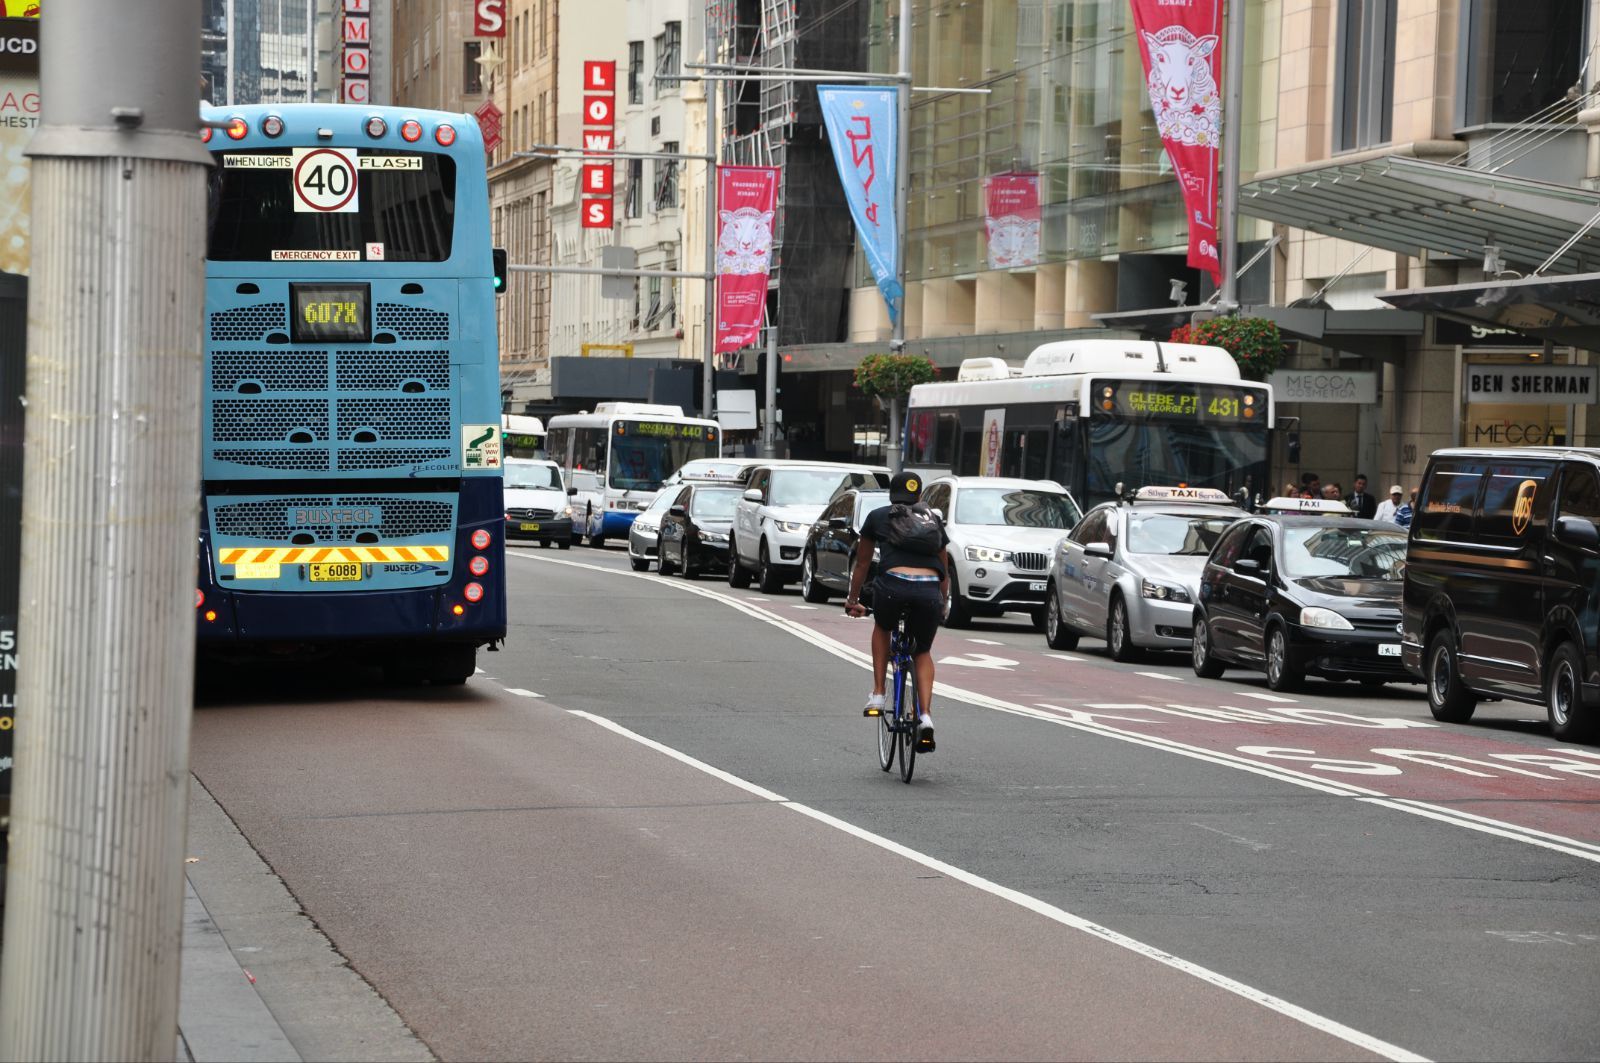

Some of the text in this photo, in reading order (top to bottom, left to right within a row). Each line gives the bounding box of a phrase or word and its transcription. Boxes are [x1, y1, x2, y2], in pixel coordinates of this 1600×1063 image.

[584, 66, 611, 224] LOWES
[226, 157, 291, 167] WHEN LIGHTS
[360, 158, 420, 168] FLASH
[303, 164, 349, 196] 40
[274, 251, 358, 260] EMERGENCY EXIT
[305, 302, 357, 323] 607X
[1286, 375, 1357, 390] MECCA
[1471, 374, 1591, 394] BEN SHERMAN
[1287, 389, 1356, 399] COSMETICA
[1128, 392, 1240, 417] GLEBE PT 431
[1149, 404, 1183, 413] GEORGE
[1185, 406, 1197, 414] ST
[1475, 424, 1556, 444] MECCA
[1147, 489, 1168, 497] Silver
[1170, 489, 1198, 498] TAXI
[1514, 496, 1532, 526] ups
[328, 565, 357, 577] 6088
